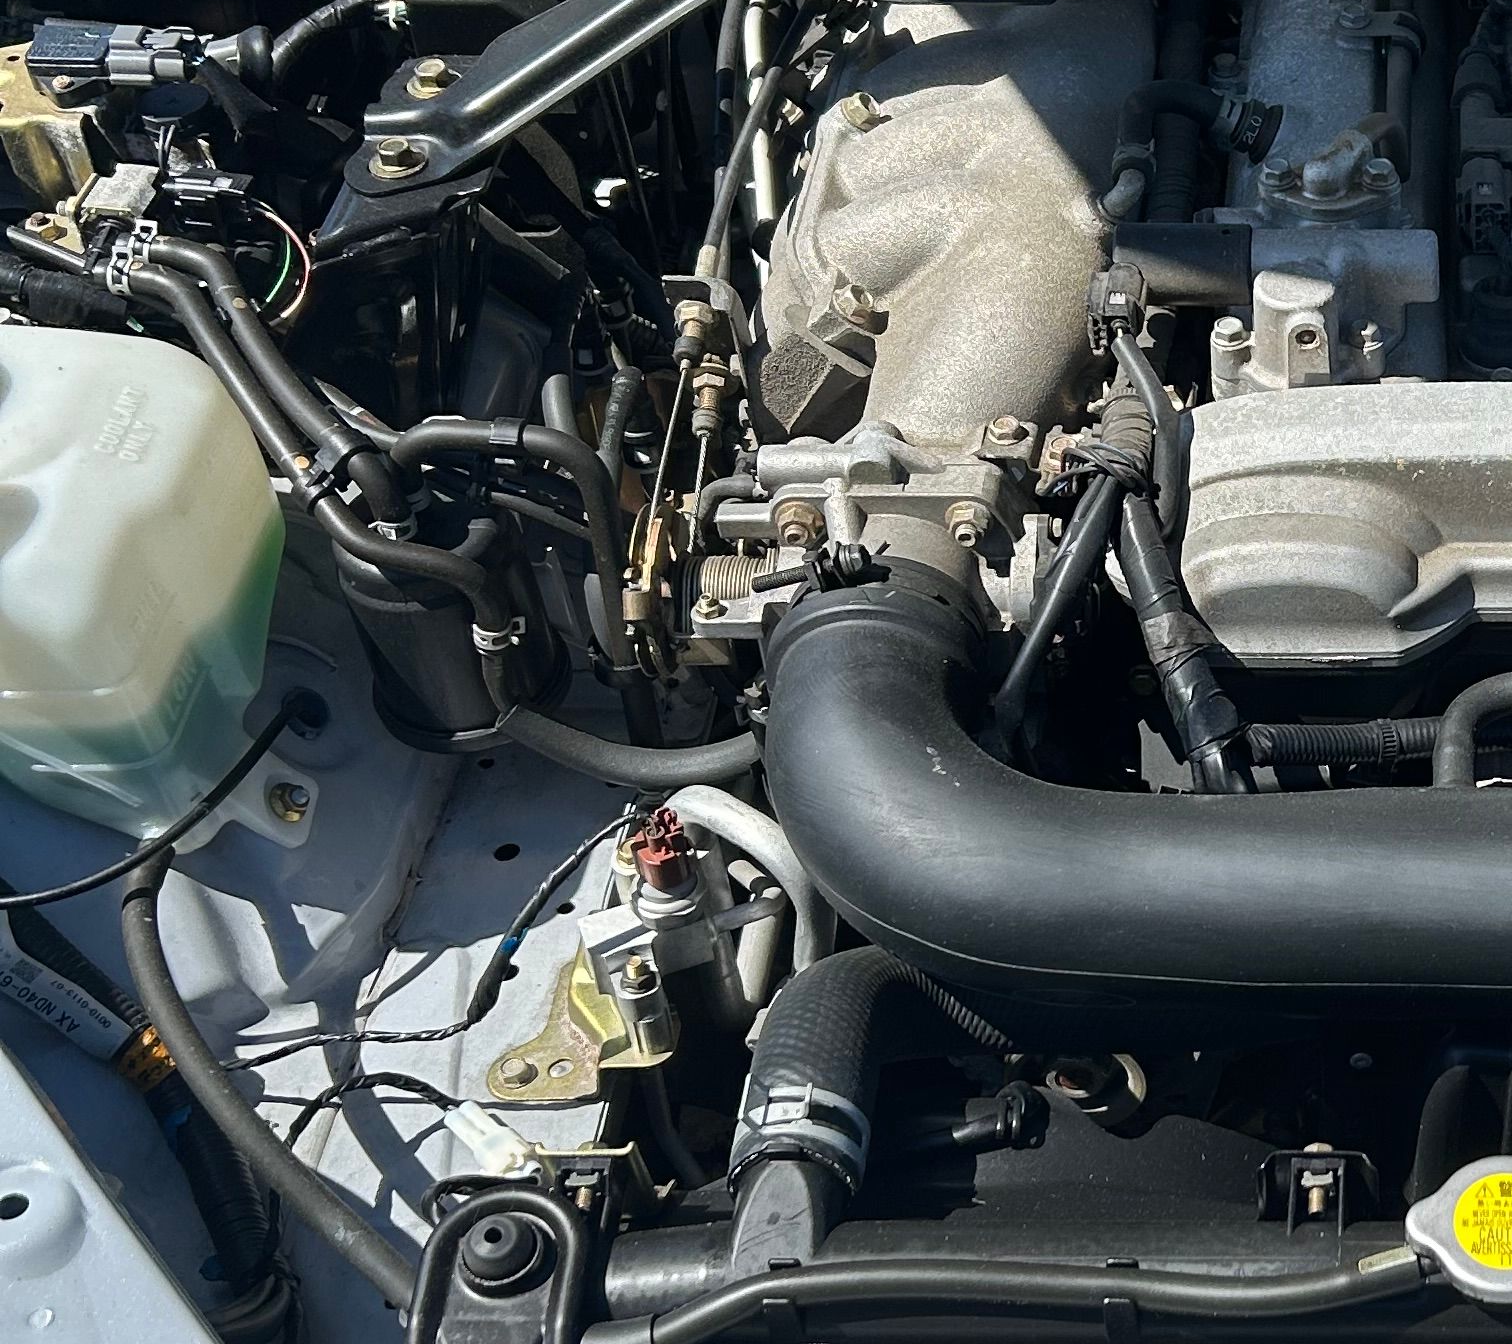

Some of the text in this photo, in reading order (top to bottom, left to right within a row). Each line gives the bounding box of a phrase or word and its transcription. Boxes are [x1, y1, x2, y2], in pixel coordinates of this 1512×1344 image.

[94, 386, 142, 454] COOLANT
[119, 420, 153, 462] ONLY
[55, 1010, 81, 1033] AX
[1472, 1210, 1490, 1218] NEVER
[1491, 1210, 1507, 1218] OPEN
